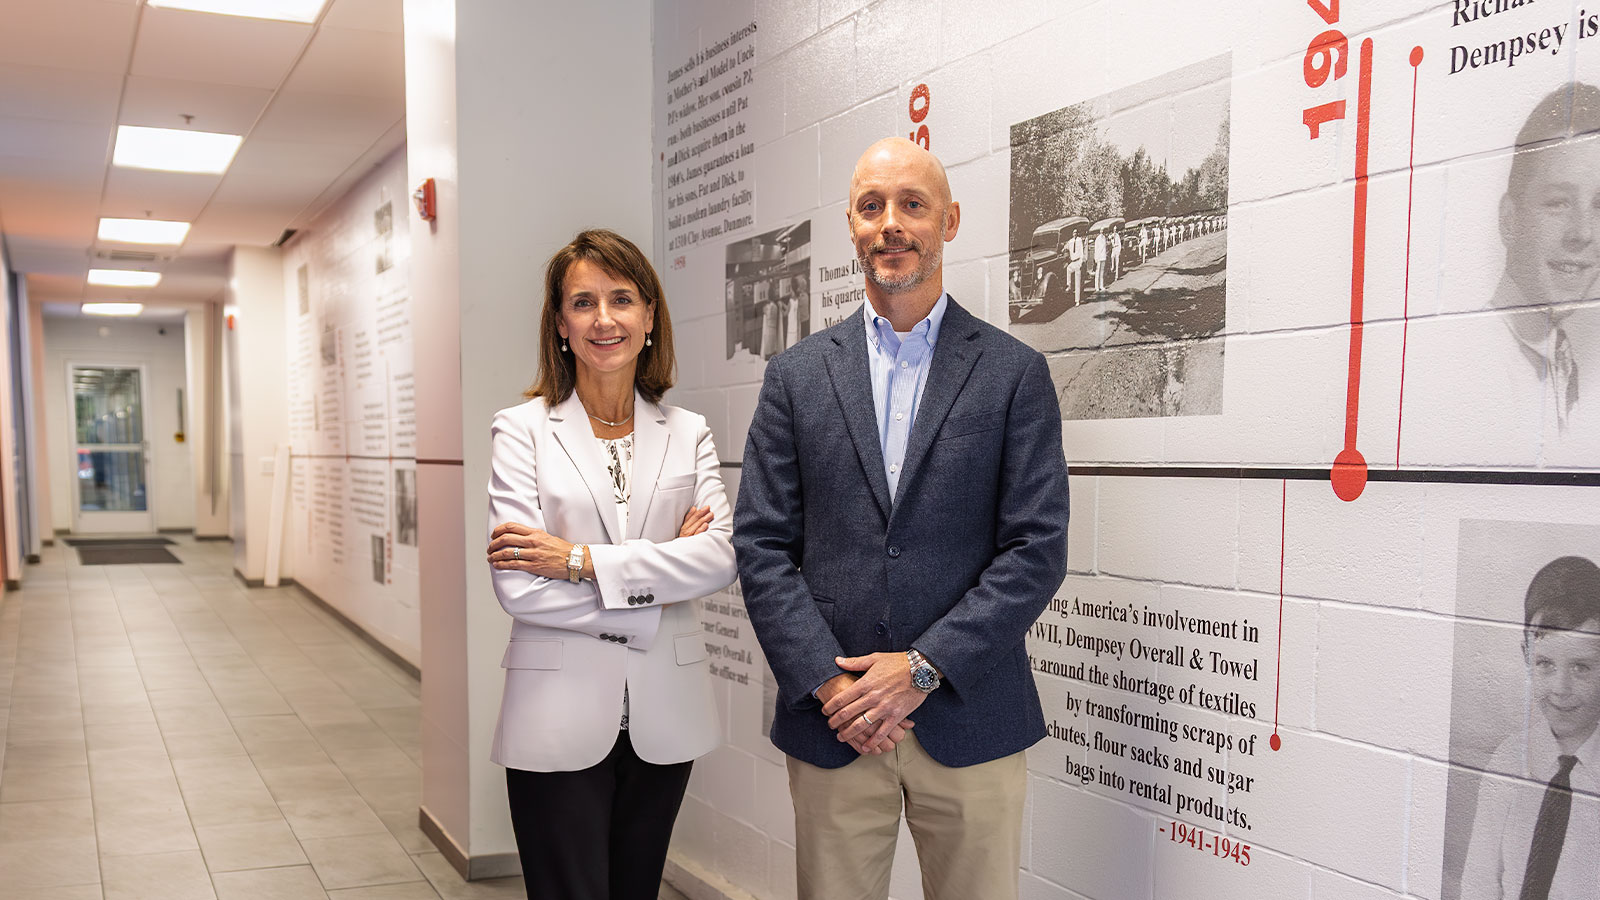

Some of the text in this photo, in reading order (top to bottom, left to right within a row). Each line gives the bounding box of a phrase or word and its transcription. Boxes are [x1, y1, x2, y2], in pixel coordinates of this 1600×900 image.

[705, 38, 730, 60] business
[730, 22, 758, 46] interests
[1448, 9, 1599, 75] Dempsey is
[698, 69, 708, 87] and
[710, 58, 728, 79] Model
[737, 44, 755, 66] Uncle
[692, 111, 721, 134] businesses
[737, 96, 748, 112] Pat
[703, 152, 735, 178] guarantees
[698, 183, 709, 198] Pat
[708, 197, 730, 216] laundry
[818, 264, 850, 283] Thomas
[822, 291, 833, 308] his
[1071, 596, 1139, 625] America's
[1143, 605, 1238, 640] involvement
[1243, 619, 1260, 644] in
[1066, 627, 1126, 662] Dempsey
[1130, 638, 1184, 668] Overall
[1190, 648, 1204, 672] &
[1209, 651, 1259, 682] Towel
[1040, 659, 1084, 681] around
[1088, 664, 1108, 687] the
[1113, 670, 1175, 704] shortage
[1178, 683, 1196, 705] of
[1199, 688, 1256, 720] textiles
[1066, 690, 1258, 756] by transforming scraps of
[1094, 731, 1125, 758] flour
[1130, 745, 1170, 770] sacks
[1174, 756, 1202, 779] and
[1207, 766, 1254, 794] sugar
[1066, 755, 1252, 831] bags into rental products.
[1170, 821, 1252, 867] 1941-1945
